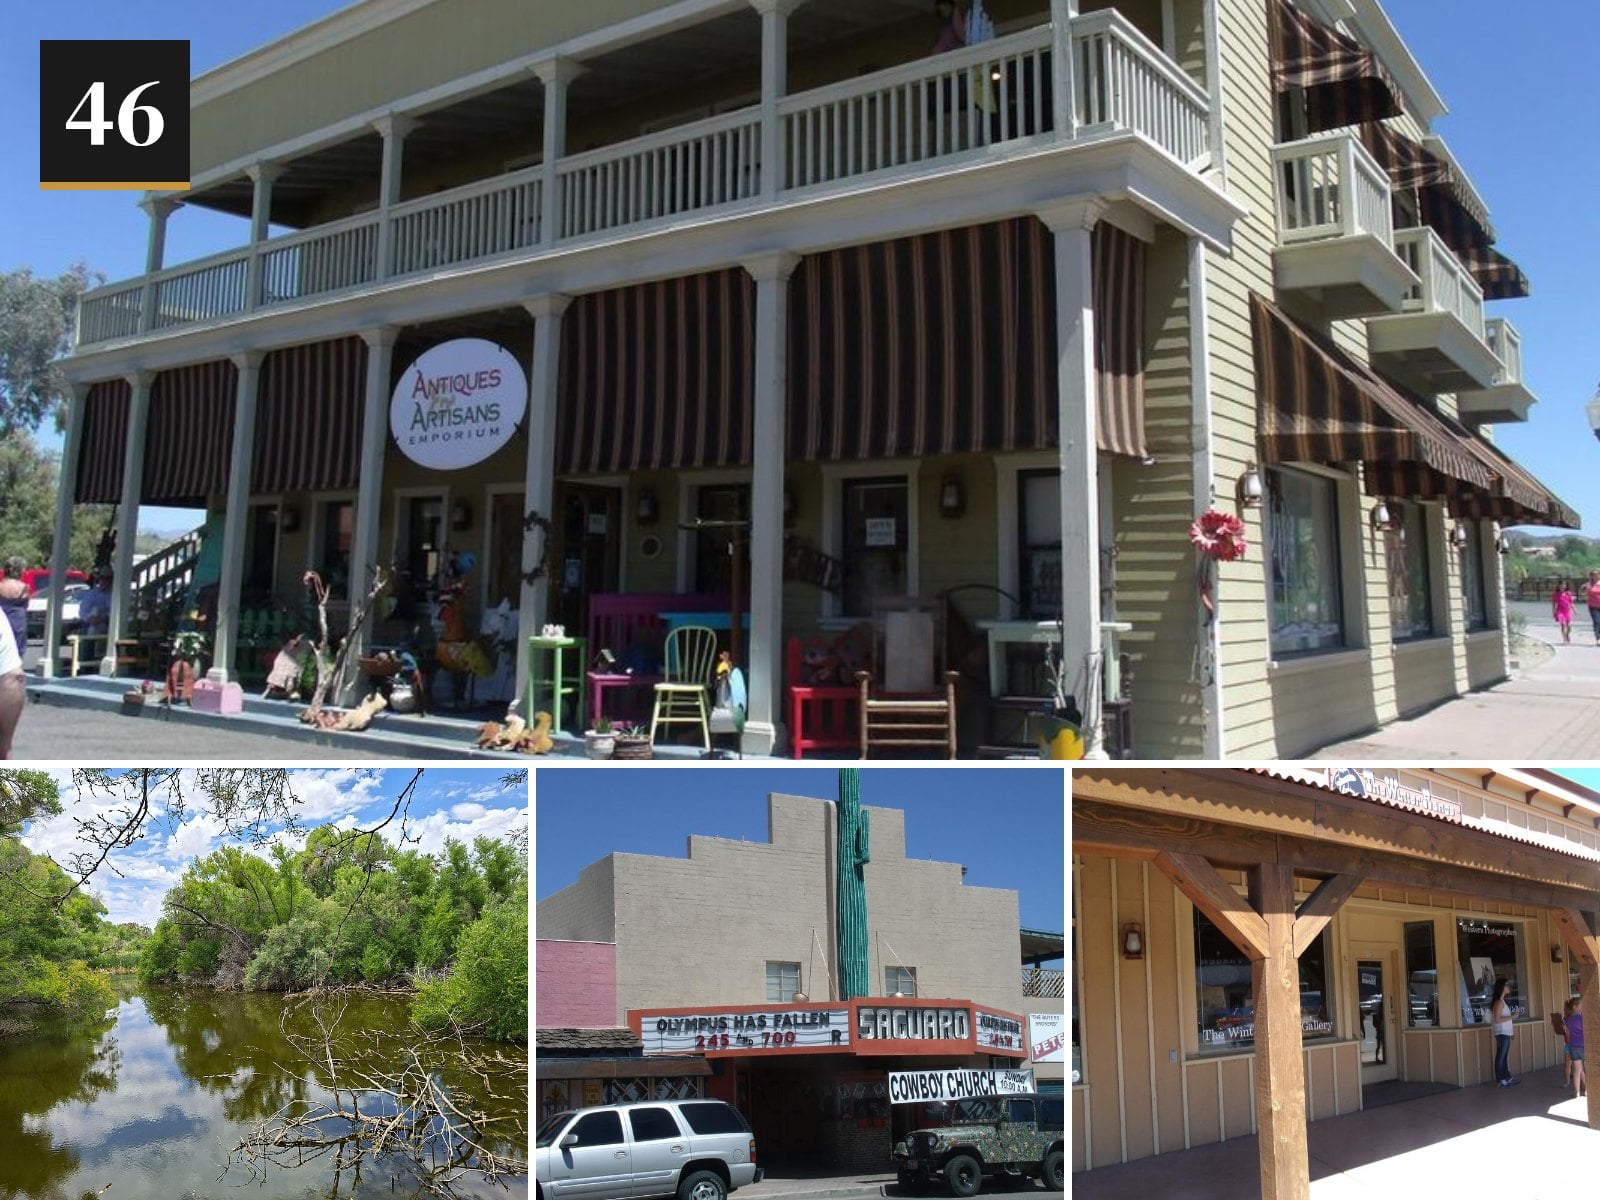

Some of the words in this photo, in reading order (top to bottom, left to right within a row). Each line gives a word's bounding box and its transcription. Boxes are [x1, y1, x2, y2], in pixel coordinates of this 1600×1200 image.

[411, 369, 501, 399] ANTIQUES
[410, 402, 500, 431] ARTISANS
[410, 428, 499, 445] EMPORIUM
[657, 1016, 728, 1033] OLYMPUS
[734, 1015, 767, 1030] HAS
[773, 1012, 830, 1028] FALLEN
[858, 1008, 970, 1040] SAGUARO
[1203, 1029, 1225, 1041] The
[1228, 1027, 1254, 1039] Wint
[1301, 1020, 1333, 1033] Gallery
[696, 1034, 730, 1048] 245
[761, 1031, 797, 1045] 700
[831, 1029, 842, 1046] R
[890, 1073, 943, 1101] COWBOY
[946, 1070, 998, 1098] CHURCH
[1004, 1070, 1027, 1085] SUNDAY
